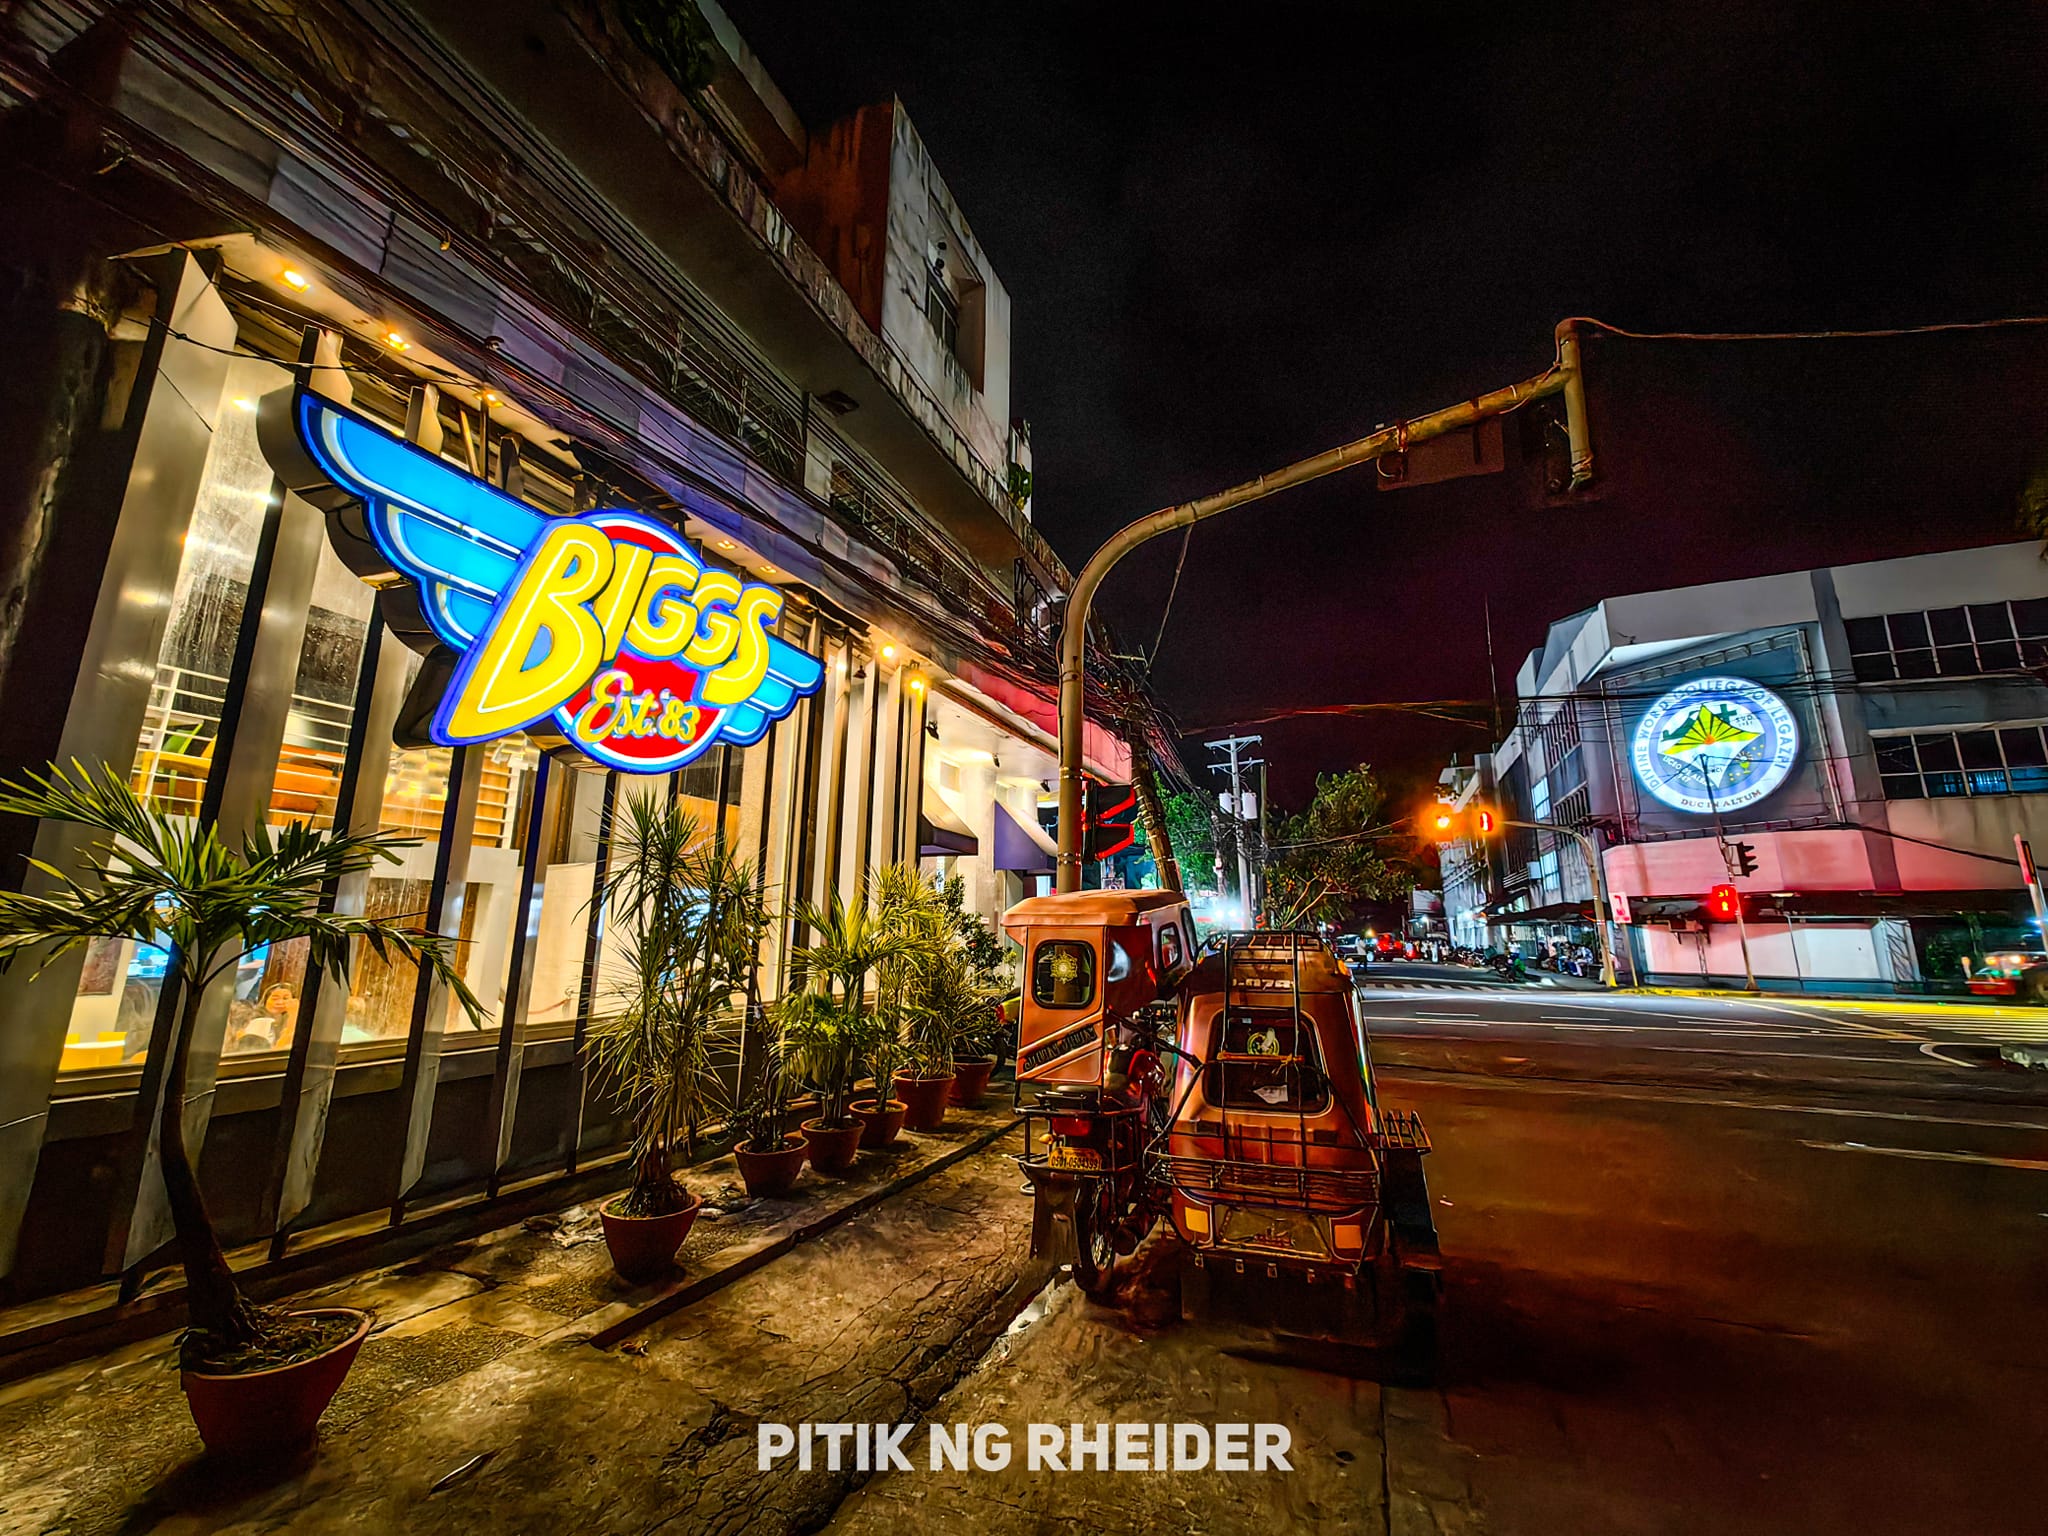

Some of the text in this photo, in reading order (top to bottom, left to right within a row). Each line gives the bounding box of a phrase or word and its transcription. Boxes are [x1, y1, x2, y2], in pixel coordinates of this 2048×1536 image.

[448, 524, 783, 739] BIGGS
[1637, 680, 1793, 791] DIVINE WORD COLLEGE OF LEGAZPI
[1681, 798, 1704, 808] DUC
[1723, 789, 1762, 807] ALTUM
